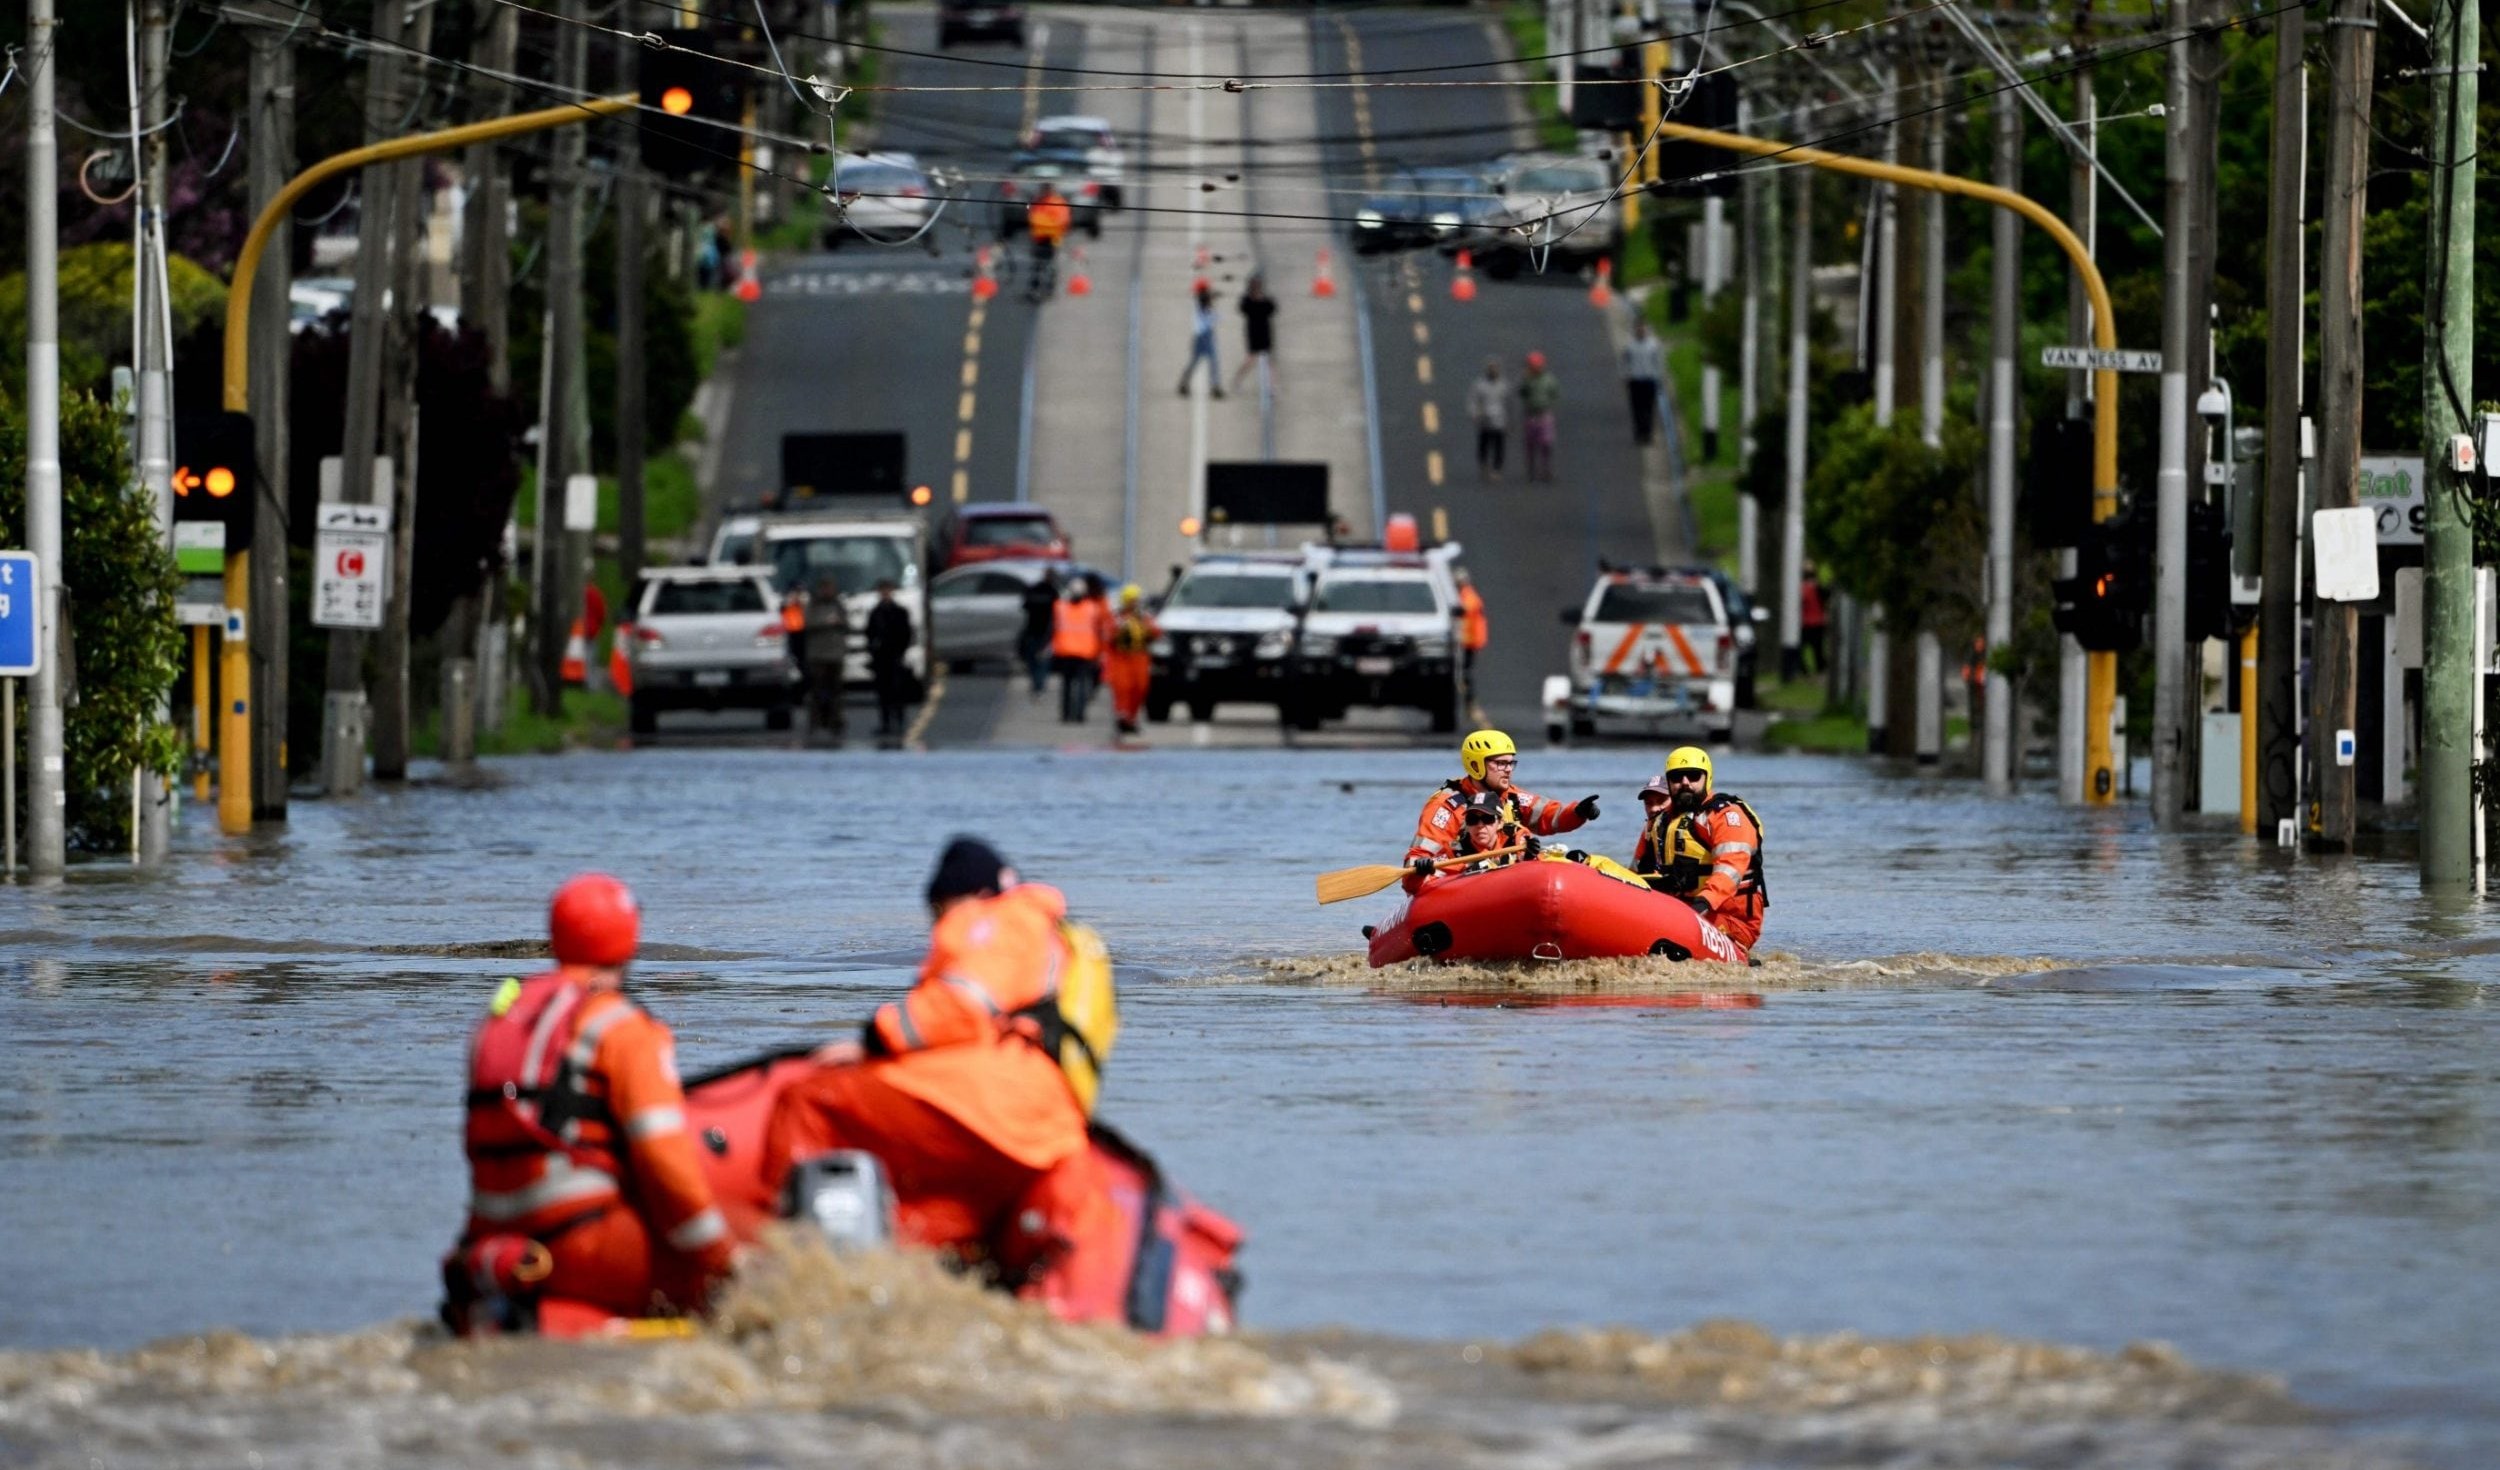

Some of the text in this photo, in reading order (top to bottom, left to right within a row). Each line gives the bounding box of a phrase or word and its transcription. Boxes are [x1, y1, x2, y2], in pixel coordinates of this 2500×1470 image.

[2044, 350, 2160, 368] VAN NESS AV
